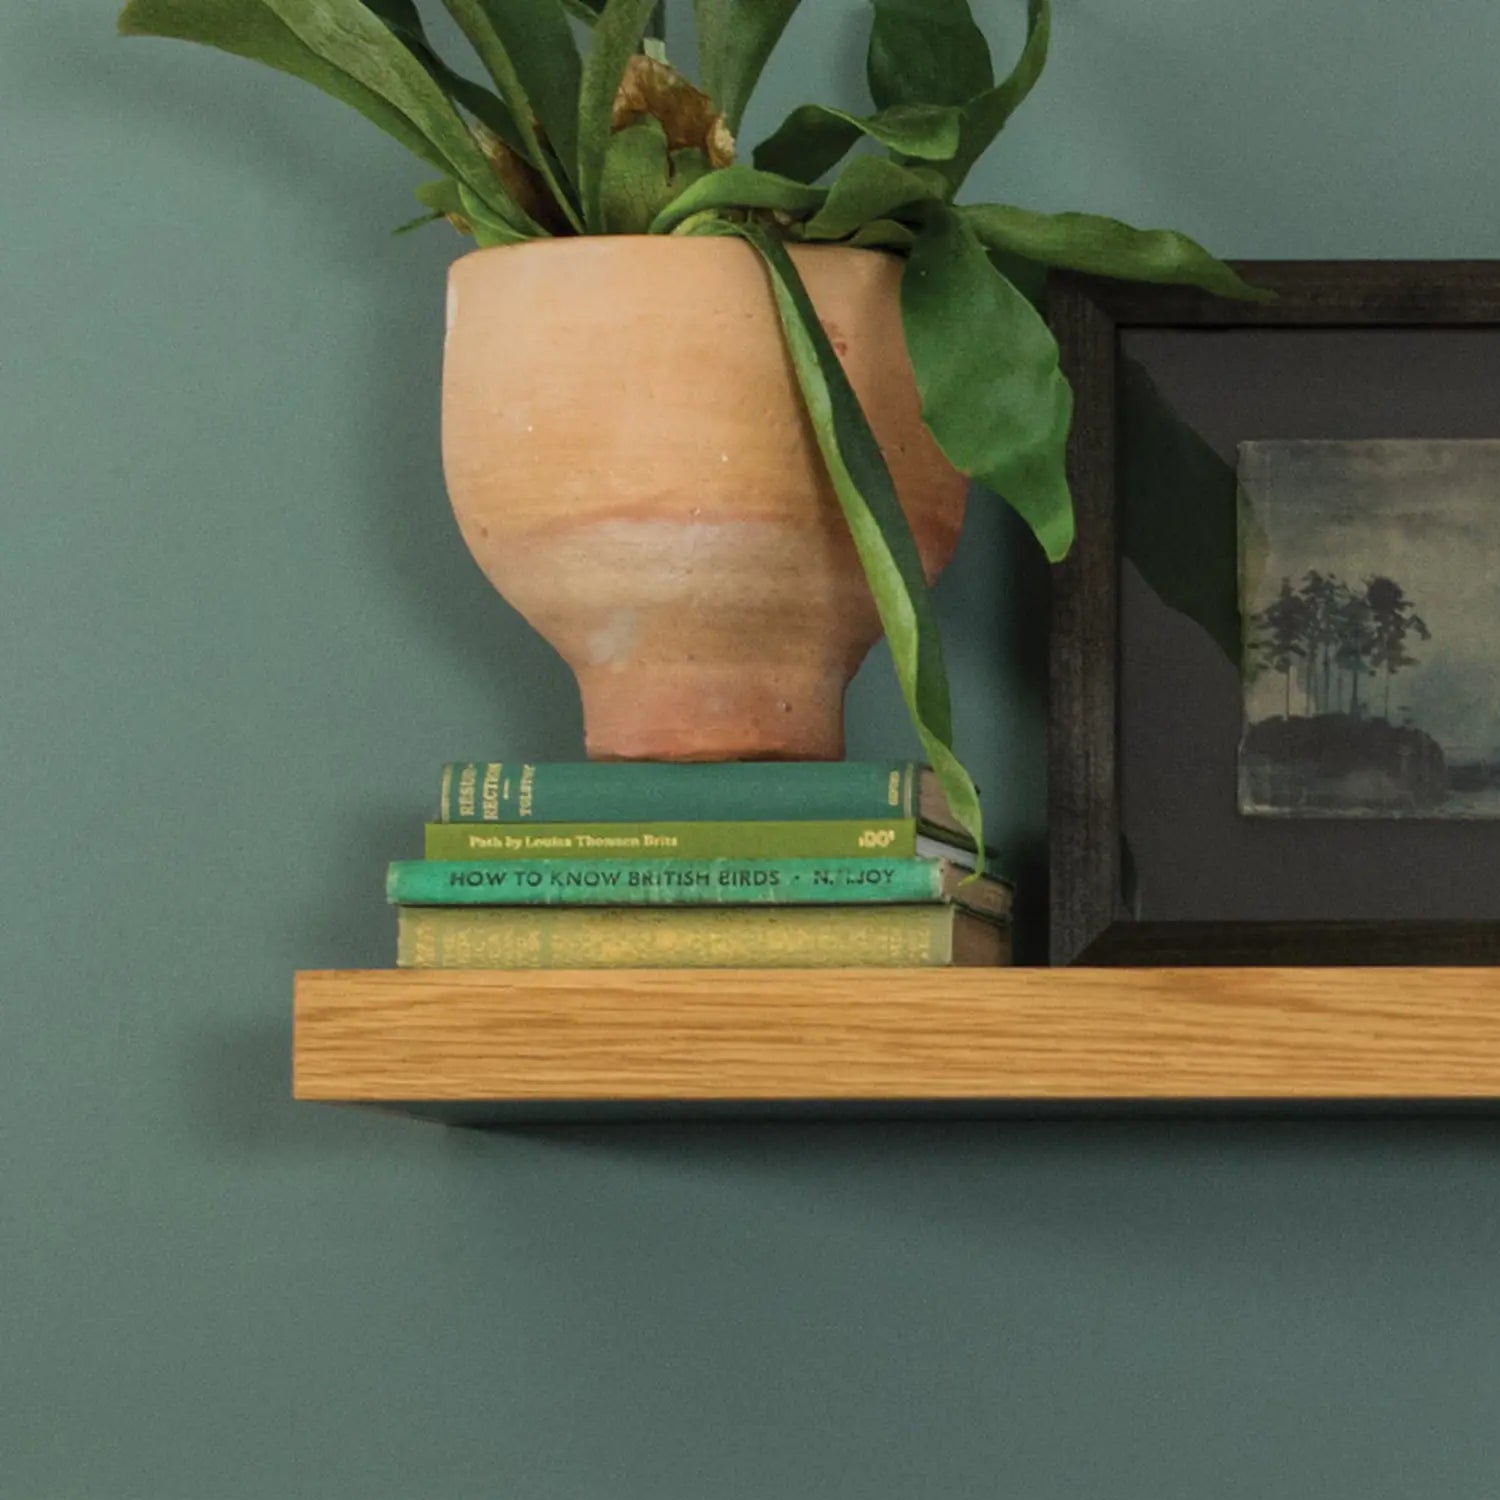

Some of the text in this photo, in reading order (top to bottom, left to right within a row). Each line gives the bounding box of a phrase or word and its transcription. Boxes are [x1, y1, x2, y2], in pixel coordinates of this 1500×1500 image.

[469, 836, 502, 848] Path
[505, 836, 521, 849] by
[450, 871, 507, 887] HOW
[515, 871, 542, 887] TO
[550, 871, 621, 887] KNOW
[628, 870, 710, 887] BRITISH
[718, 870, 780, 886] BIRDS
